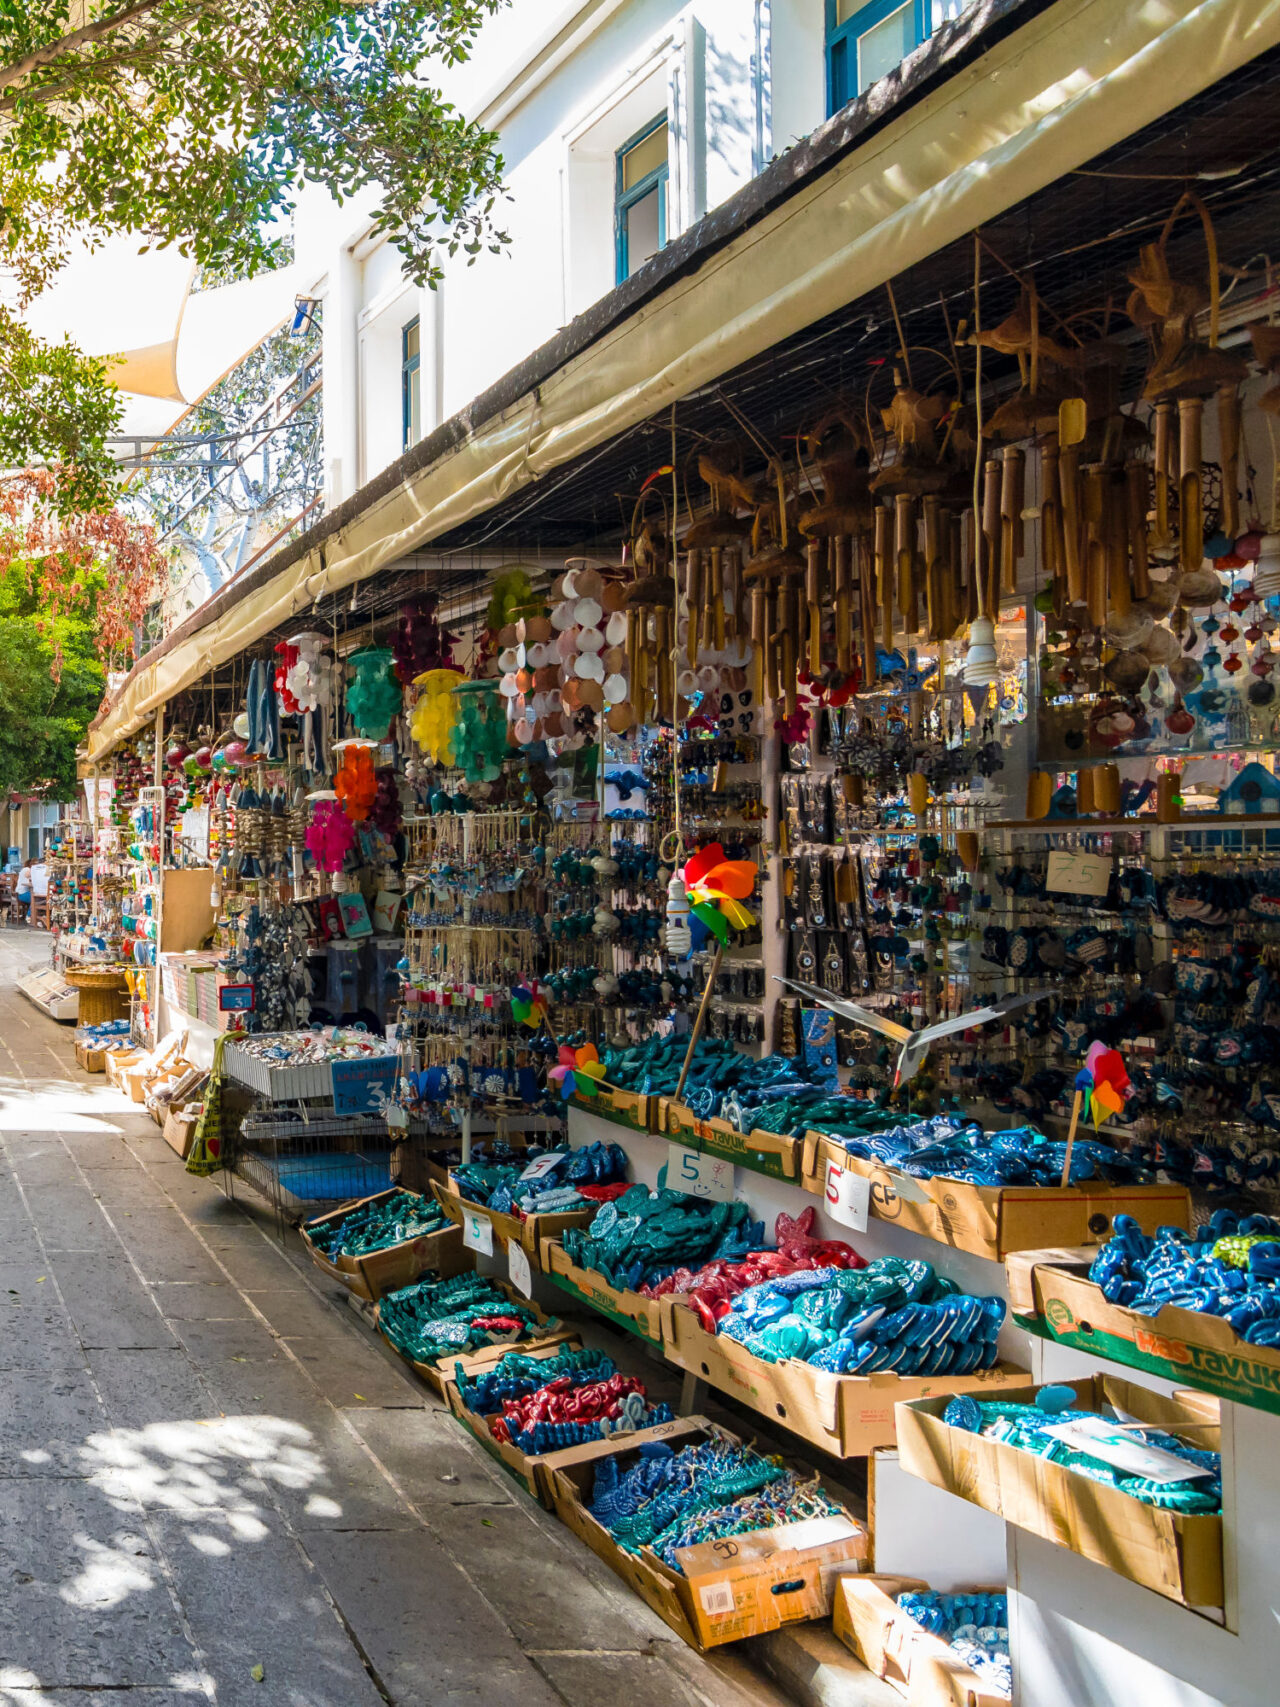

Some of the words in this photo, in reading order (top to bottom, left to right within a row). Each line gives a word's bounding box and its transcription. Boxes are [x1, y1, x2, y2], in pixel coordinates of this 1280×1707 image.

[366, 1081, 386, 1107] 3
[681, 1153, 701, 1181] 5
[825, 1165, 844, 1204] 5
[472, 1216, 481, 1240] 5
